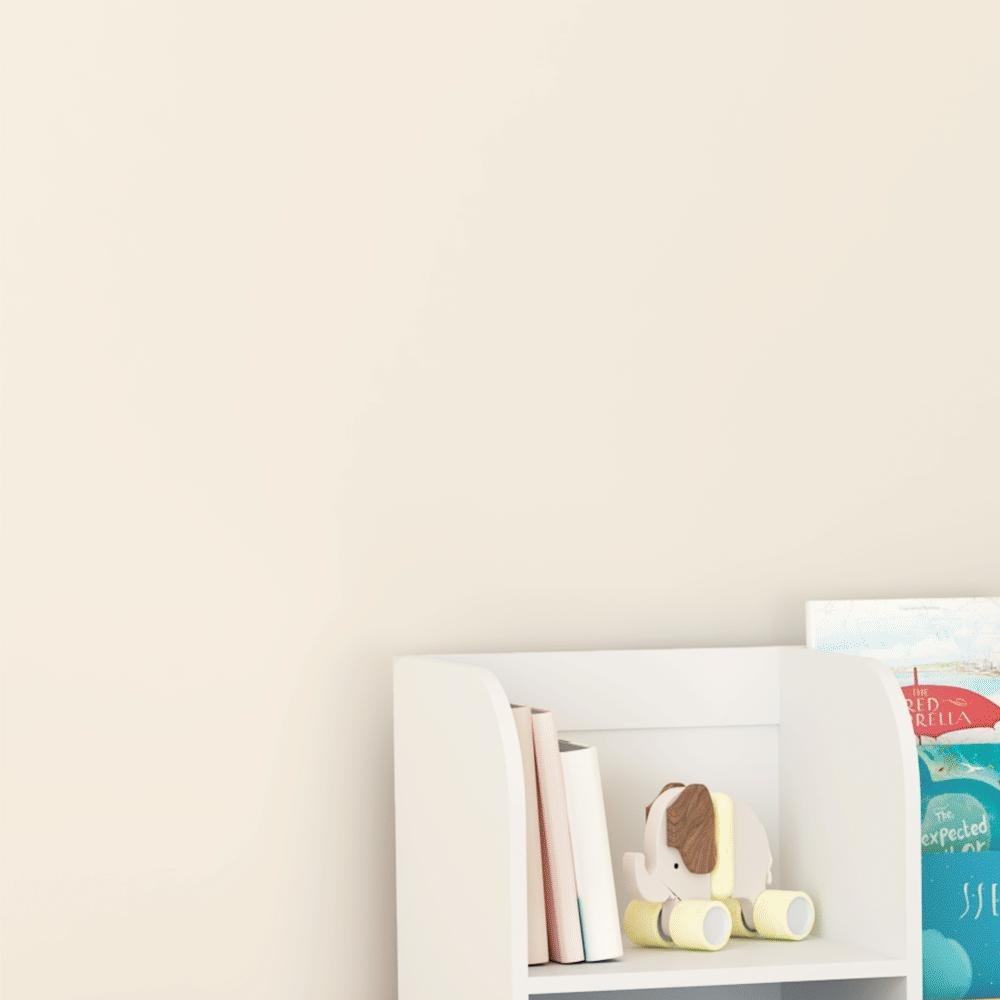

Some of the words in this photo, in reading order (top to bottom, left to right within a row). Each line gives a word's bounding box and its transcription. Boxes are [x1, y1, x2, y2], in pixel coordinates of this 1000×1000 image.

[906, 697, 939, 712] RED
[916, 711, 972, 727] RELLA
[921, 814, 988, 847] expected
